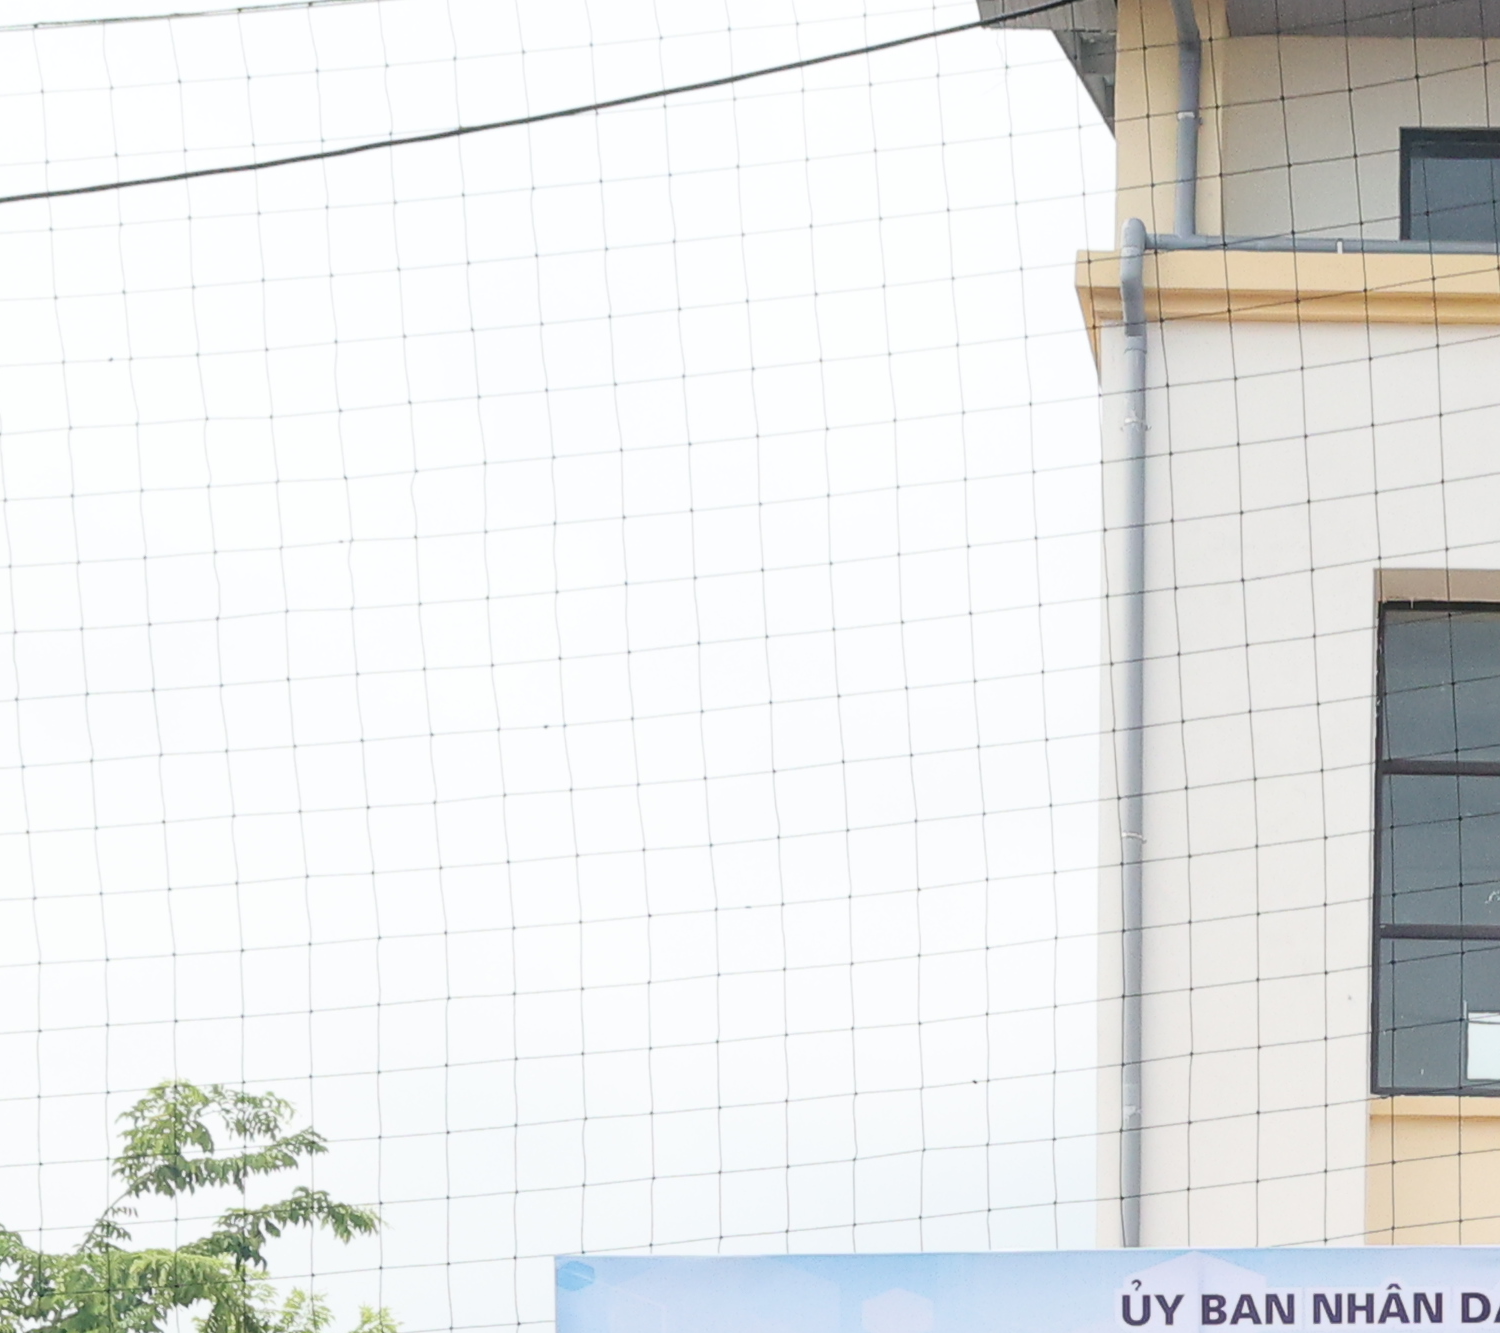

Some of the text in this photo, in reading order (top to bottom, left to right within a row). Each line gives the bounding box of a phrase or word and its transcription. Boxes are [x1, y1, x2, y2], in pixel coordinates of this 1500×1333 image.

[1122, 1279, 1184, 1326] ỦY
[1201, 1294, 1296, 1325] BAN
[1313, 1282, 1443, 1325] NHÂN
